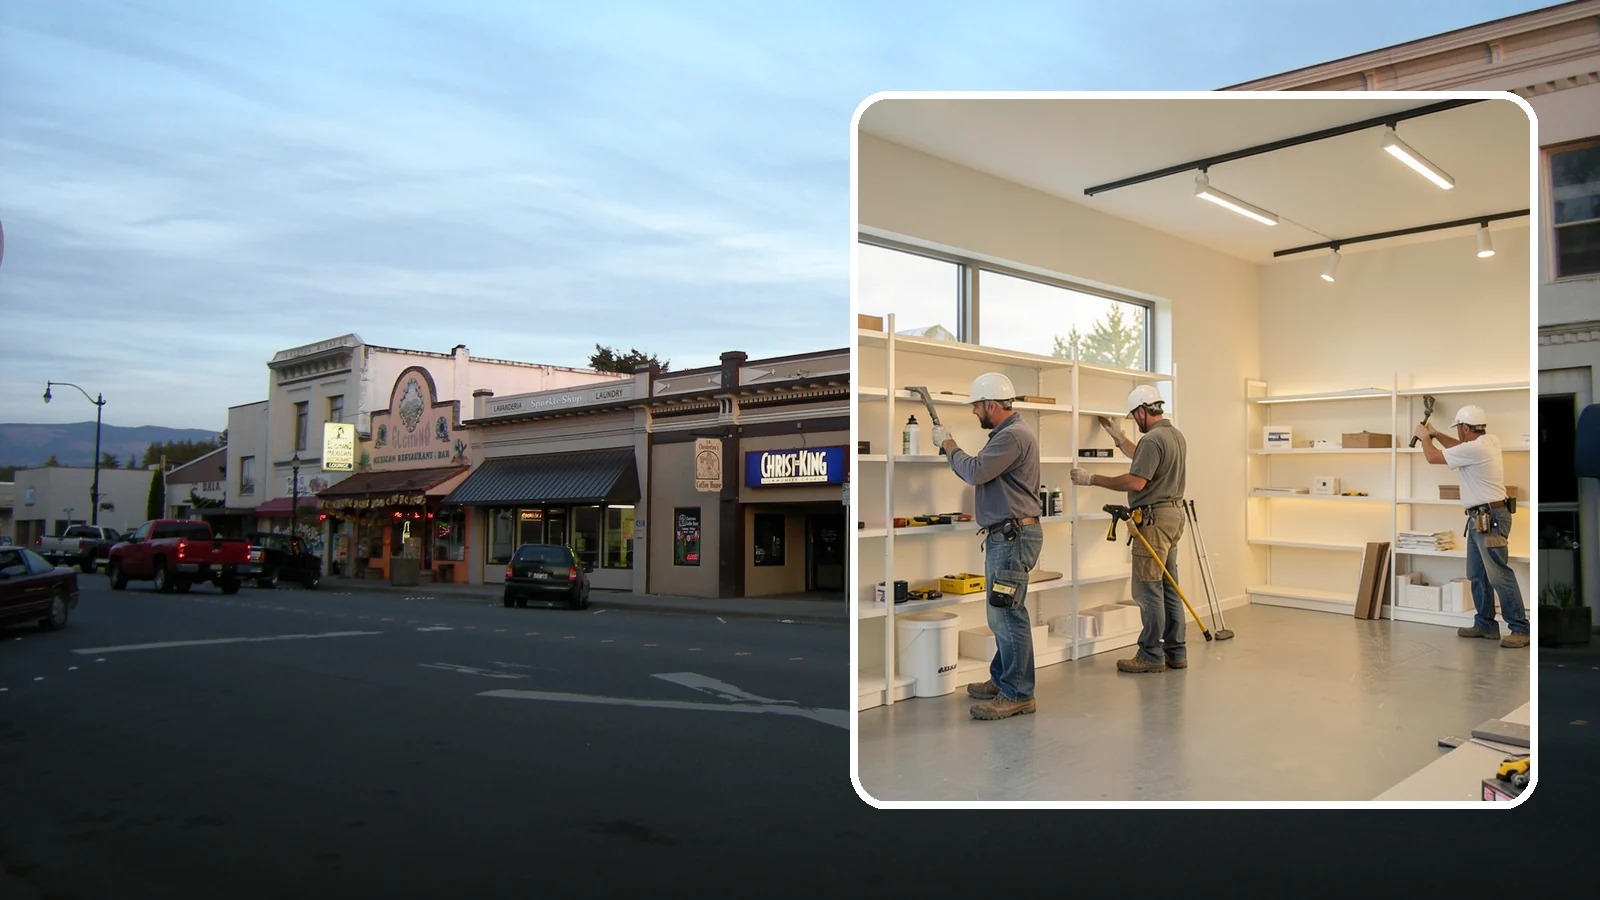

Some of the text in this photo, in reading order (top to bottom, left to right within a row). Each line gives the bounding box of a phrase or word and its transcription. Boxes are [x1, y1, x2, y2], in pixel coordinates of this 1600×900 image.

[595, 389, 623, 400] LAUNDRY
[494, 402, 522, 412] LAVANDERIA
[530, 394, 582, 409] Sparkle Shop
[373, 454, 396, 464] MEXICAN
[398, 451, 433, 462] RESTAURANT
[438, 450, 450, 459] BAR
[696, 480, 709, 489] Coffee
